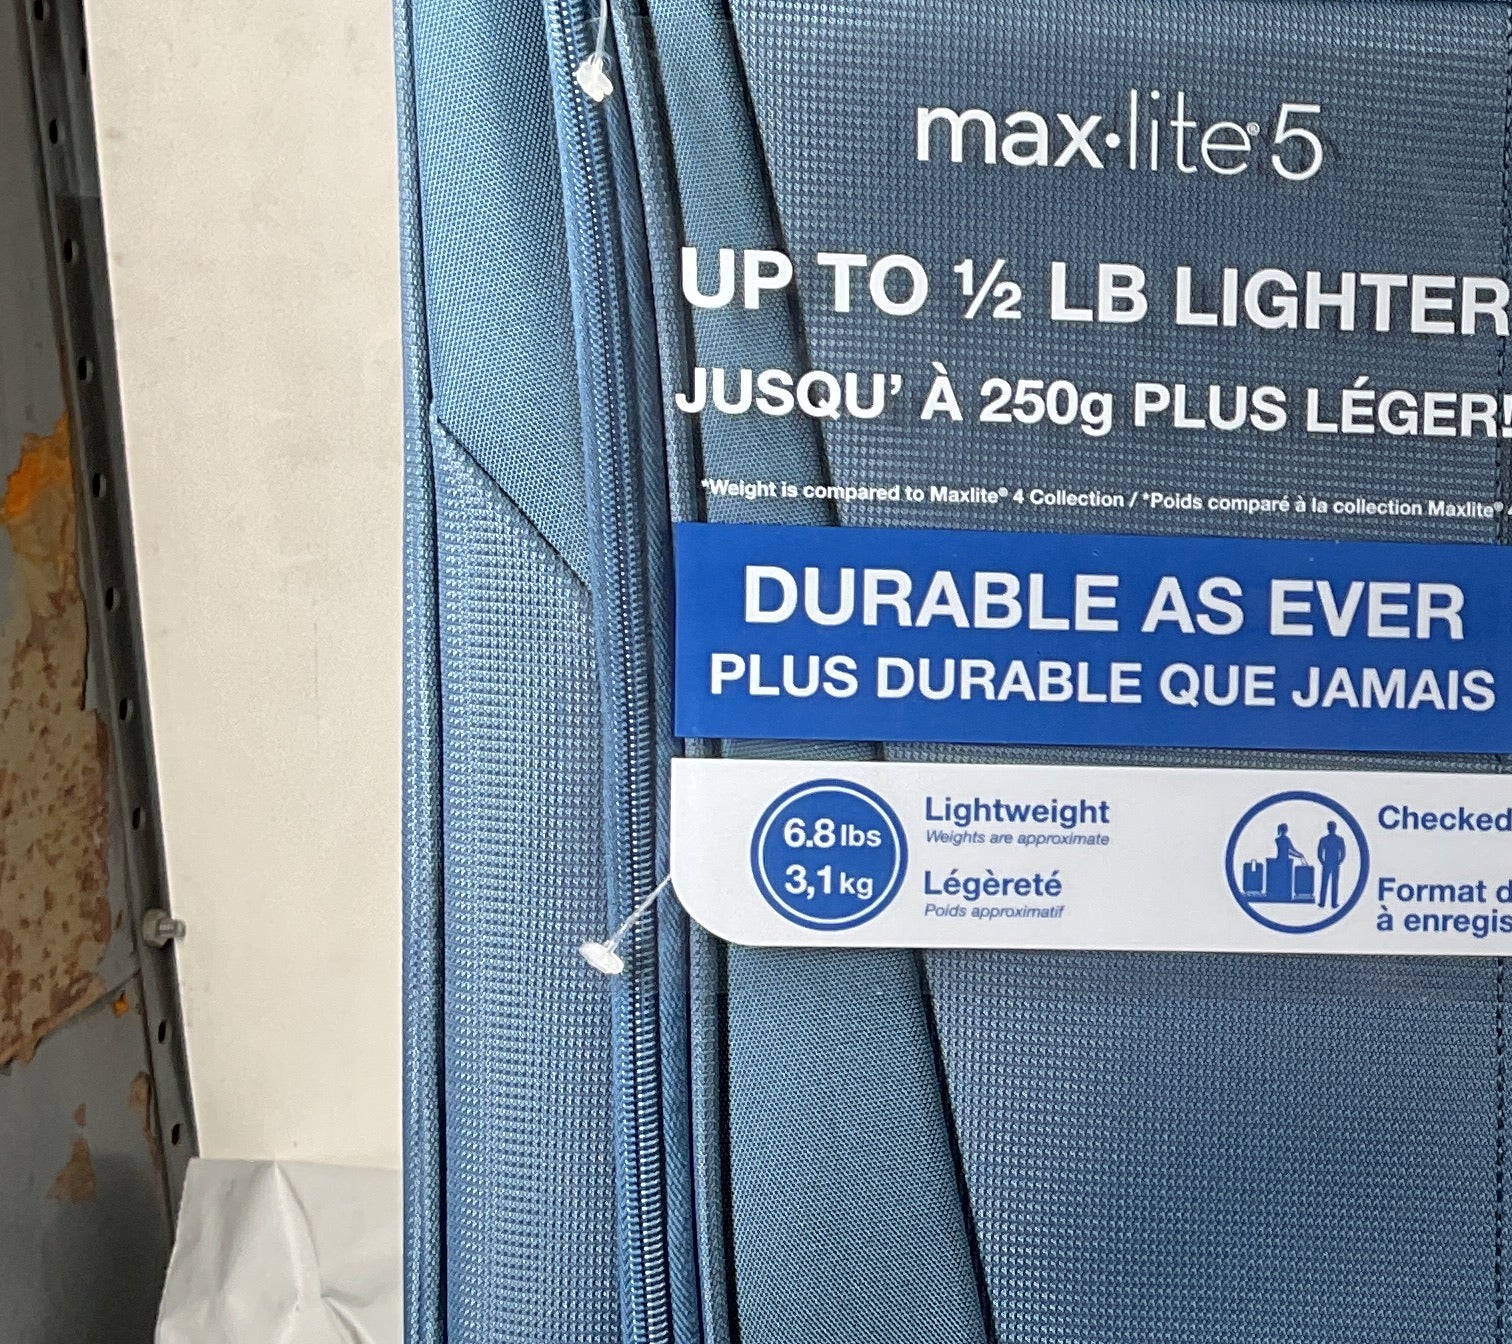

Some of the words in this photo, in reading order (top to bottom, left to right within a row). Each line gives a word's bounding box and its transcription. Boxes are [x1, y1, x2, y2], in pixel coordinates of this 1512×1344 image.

[679, 246, 794, 311] UP
[817, 252, 929, 317] TO
[1051, 261, 1149, 323] LB
[921, 361, 963, 422] À
[979, 379, 1115, 436] 250g
[1133, 384, 1287, 433] PLUS
[781, 483, 798, 498] is
[803, 485, 900, 504] compared
[904, 487, 925, 501] to
[1012, 491, 1025, 504] 4
[1029, 490, 1125, 508] Collection
[1207, 496, 1290, 514] comparé
[1295, 497, 1306, 513] à
[1312, 499, 1328, 513] la
[1333, 501, 1423, 516] collection
[745, 565, 1119, 633] DURABLE
[1141, 577, 1244, 637] AS
[1270, 579, 1466, 641] EVER
[710, 653, 859, 700] PLUS
[877, 656, 1142, 705] DURABLE
[1159, 662, 1275, 708] QUE
[1292, 667, 1496, 712] JAMAIS
[925, 796, 1110, 828] Lightweight
[1378, 805, 1512, 832] Checked
[783, 818, 835, 849] 6.8
[840, 823, 882, 848] lbs
[926, 829, 985, 846] Weights
[990, 833, 1013, 844] are
[1017, 832, 1110, 848] approximate
[785, 864, 832, 899] 3,1
[840, 872, 873, 900] kg
[924, 870, 1062, 901] Légèreté
[1378, 877, 1487, 904] Format
[924, 903, 966, 917] Poids
[970, 903, 1065, 920] approximatif
[1376, 905, 1394, 931] à
